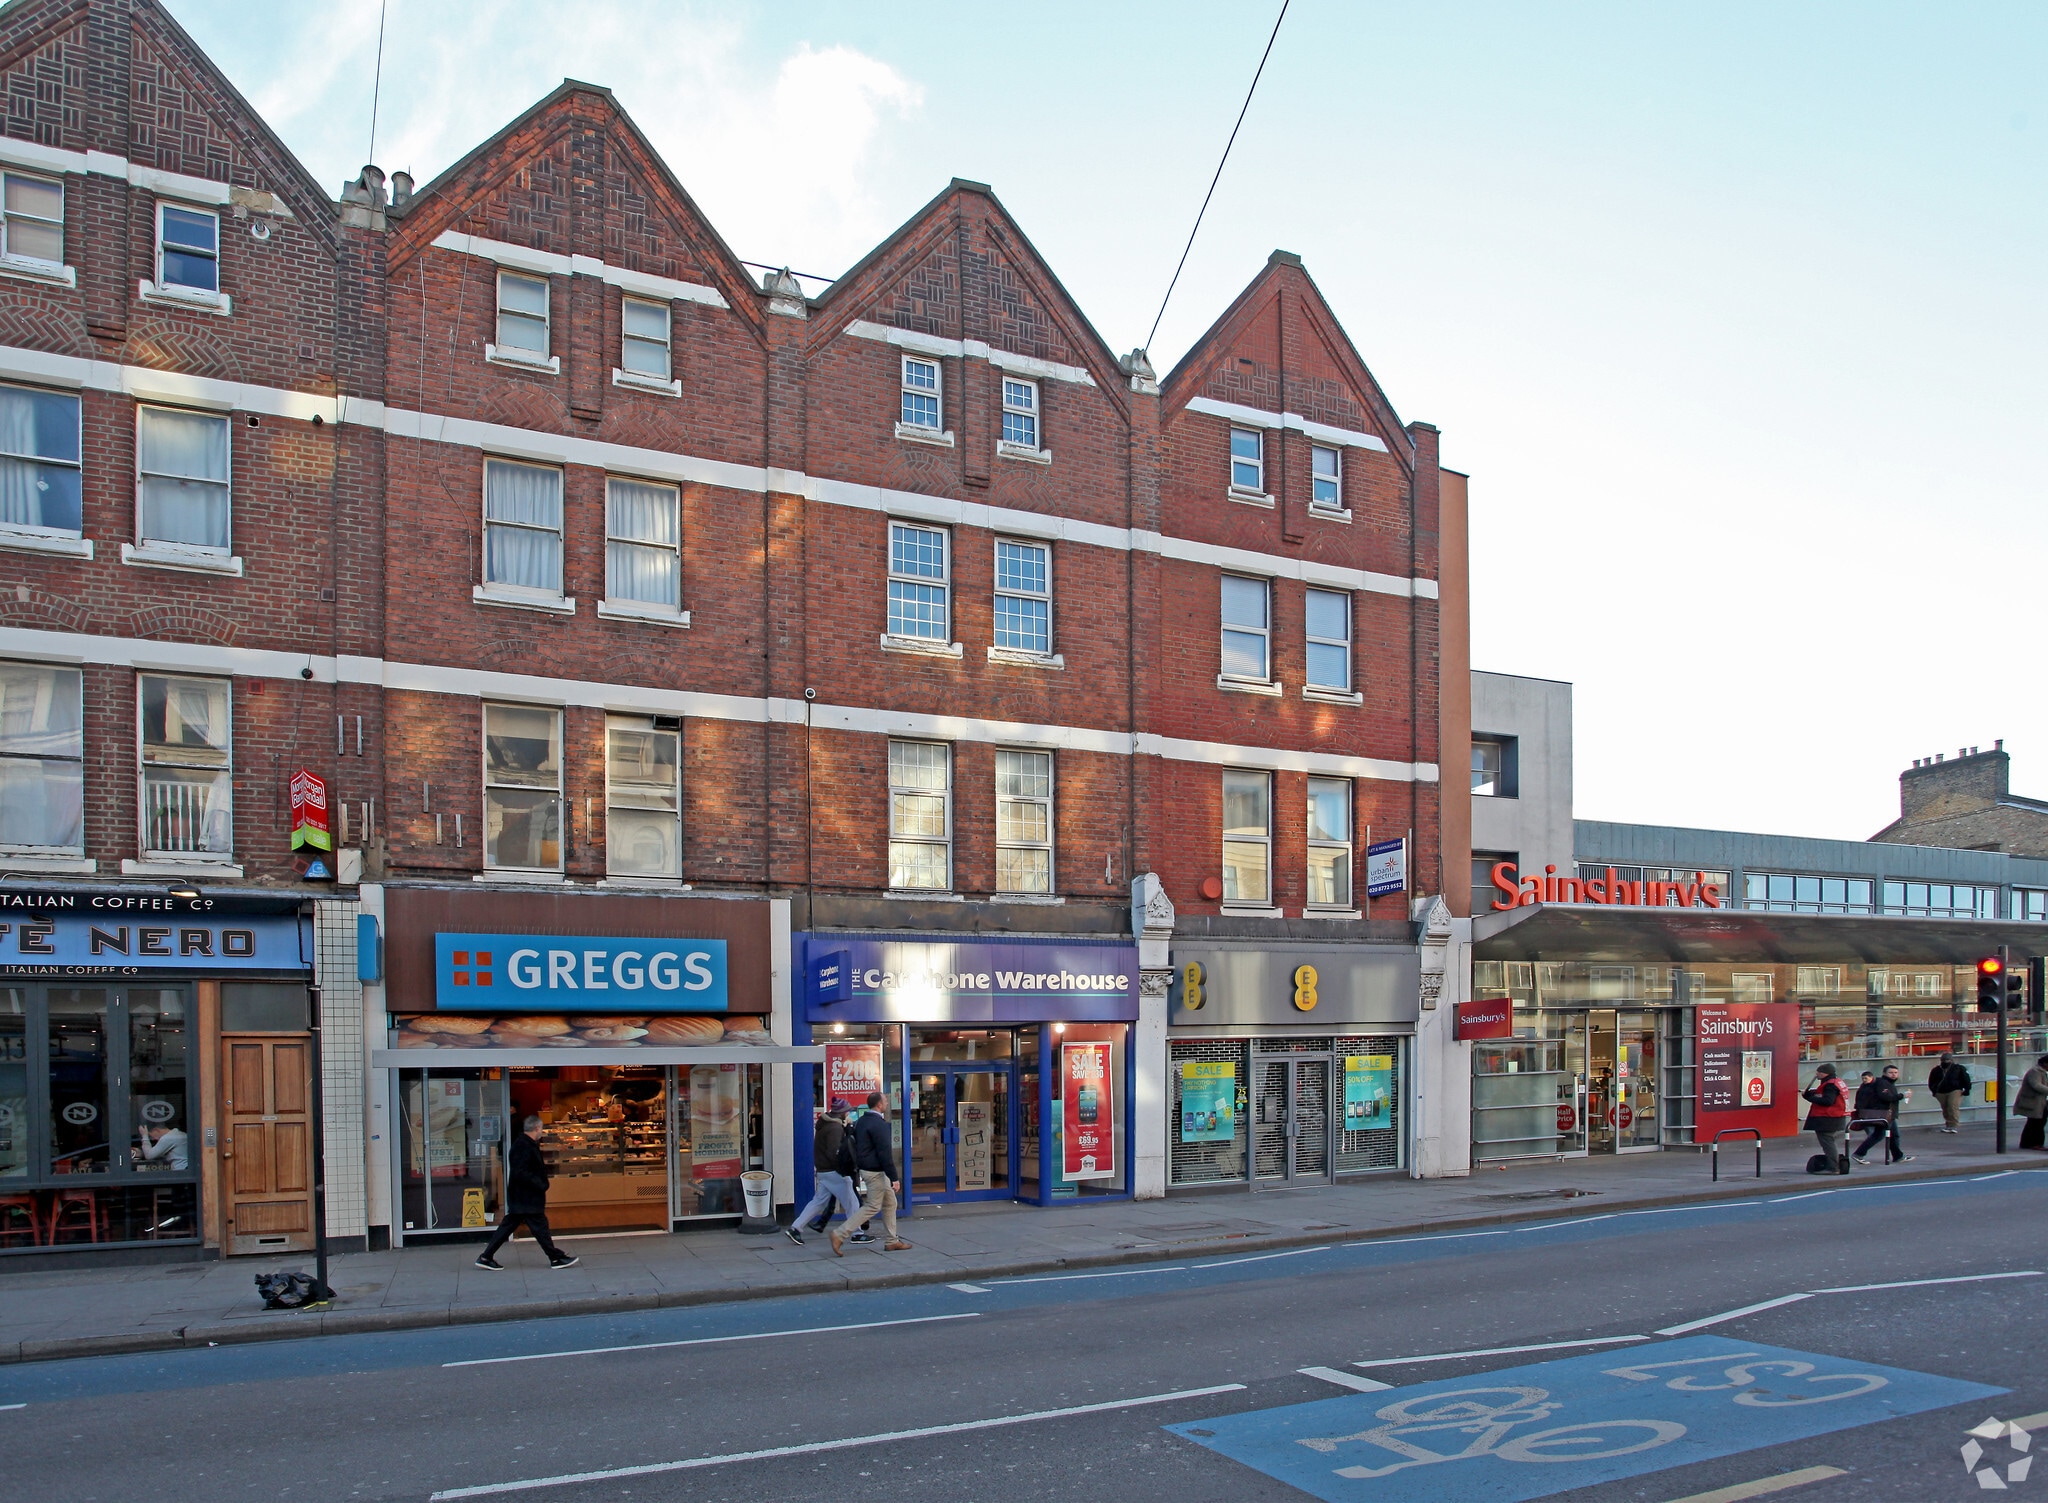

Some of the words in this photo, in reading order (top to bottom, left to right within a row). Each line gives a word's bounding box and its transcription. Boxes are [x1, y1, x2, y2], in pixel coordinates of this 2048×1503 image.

[1370, 867, 1389, 876] urban
[1371, 871, 1400, 882] spectrum
[1491, 862, 1720, 911] Sainsbury's
[0, 895, 74, 907] TALIAN
[92, 896, 173, 910] COFFEE
[89, 925, 255, 956] NERO
[6, 965, 59, 974] ITALIAN
[507, 948, 713, 992] GREGGS
[851, 968, 860, 989] THE
[863, 968, 990, 990] Carhone
[995, 970, 1129, 990] Warehouse
[1461, 1013, 1506, 1025] Sainsbury's
[1701, 1017, 1773, 1037] Sainsbury's
[1072, 1053, 1103, 1070] SALE
[1357, 1058, 1381, 1068] SALE
[831, 1060, 876, 1081] £200
[1195, 1065, 1222, 1076] SALE
[1361, 1075, 1374, 1083] OFF
[831, 1080, 876, 1091] CASHBACK
[1751, 1083, 1762, 1094] £3
[698, 1142, 734, 1150] FROSTY
[694, 1149, 739, 1157] MORNINGS
